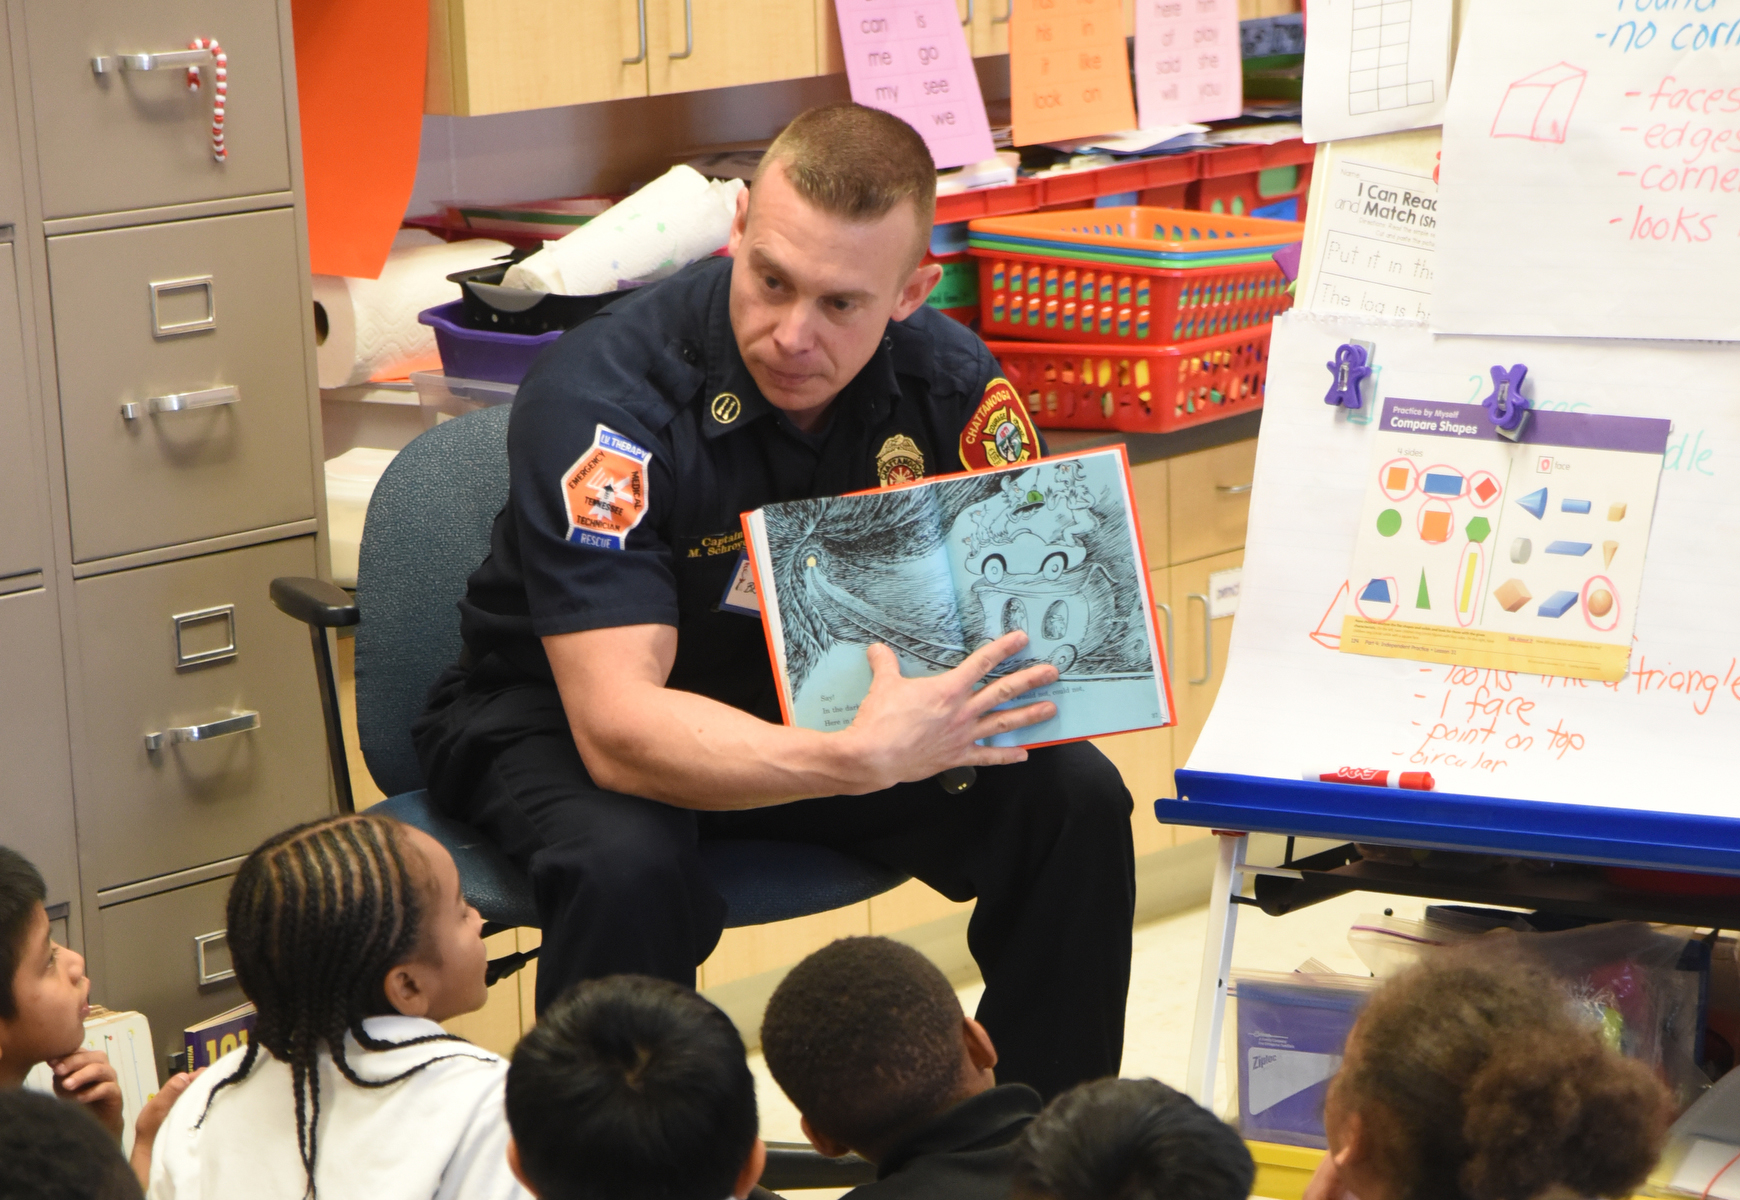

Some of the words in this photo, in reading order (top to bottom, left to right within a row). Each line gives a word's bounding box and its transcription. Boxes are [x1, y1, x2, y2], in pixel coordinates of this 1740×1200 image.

[861, 18, 888, 34] can
[914, 10, 926, 28] is
[868, 51, 892, 66] me
[918, 46, 939, 66] go
[1078, 53, 1102, 70] like
[1156, 55, 1180, 74] said
[1198, 53, 1219, 70] she
[876, 86, 898, 103] my
[923, 80, 949, 95] see
[1198, 83, 1221, 103] you
[1033, 90, 1062, 110] look
[932, 111, 955, 126] we
[1341, 169, 1360, 178] Name
[1358, 183, 1363, 196] I
[1368, 185, 1398, 203] Can
[1335, 199, 1360, 214] and
[1363, 201, 1416, 224] Match
[1328, 241, 1358, 264] Put
[1368, 250, 1381, 269] it
[1389, 260, 1402, 274] in
[1322, 282, 1350, 306] The
[1394, 305, 1406, 318] is
[966, 390, 1012, 444] CHATTANOOGA
[1392, 406, 1422, 416] Practice
[1424, 408, 1433, 418] by
[1434, 409, 1460, 419] Myself
[1390, 416, 1437, 432] Compare
[1439, 421, 1478, 435] Shapes
[612, 436, 648, 459] THERAPY
[1404, 448, 1423, 458] sides
[568, 451, 606, 489] EMERGENCY
[1555, 461, 1570, 470] face
[631, 471, 642, 510] MEDICAL
[584, 496, 624, 516] TENNESSEE
[576, 515, 620, 531] TECHNICIAN
[580, 533, 612, 548] RESCUE
[701, 532, 744, 547] Captain
[687, 548, 702, 558] M.
[1466, 685, 1535, 726] face
[1505, 733, 1534, 752] on
[1547, 718, 1585, 760] top
[1338, 766, 1380, 780] EXPO
[1252, 1055, 1277, 1070] Ziploc
